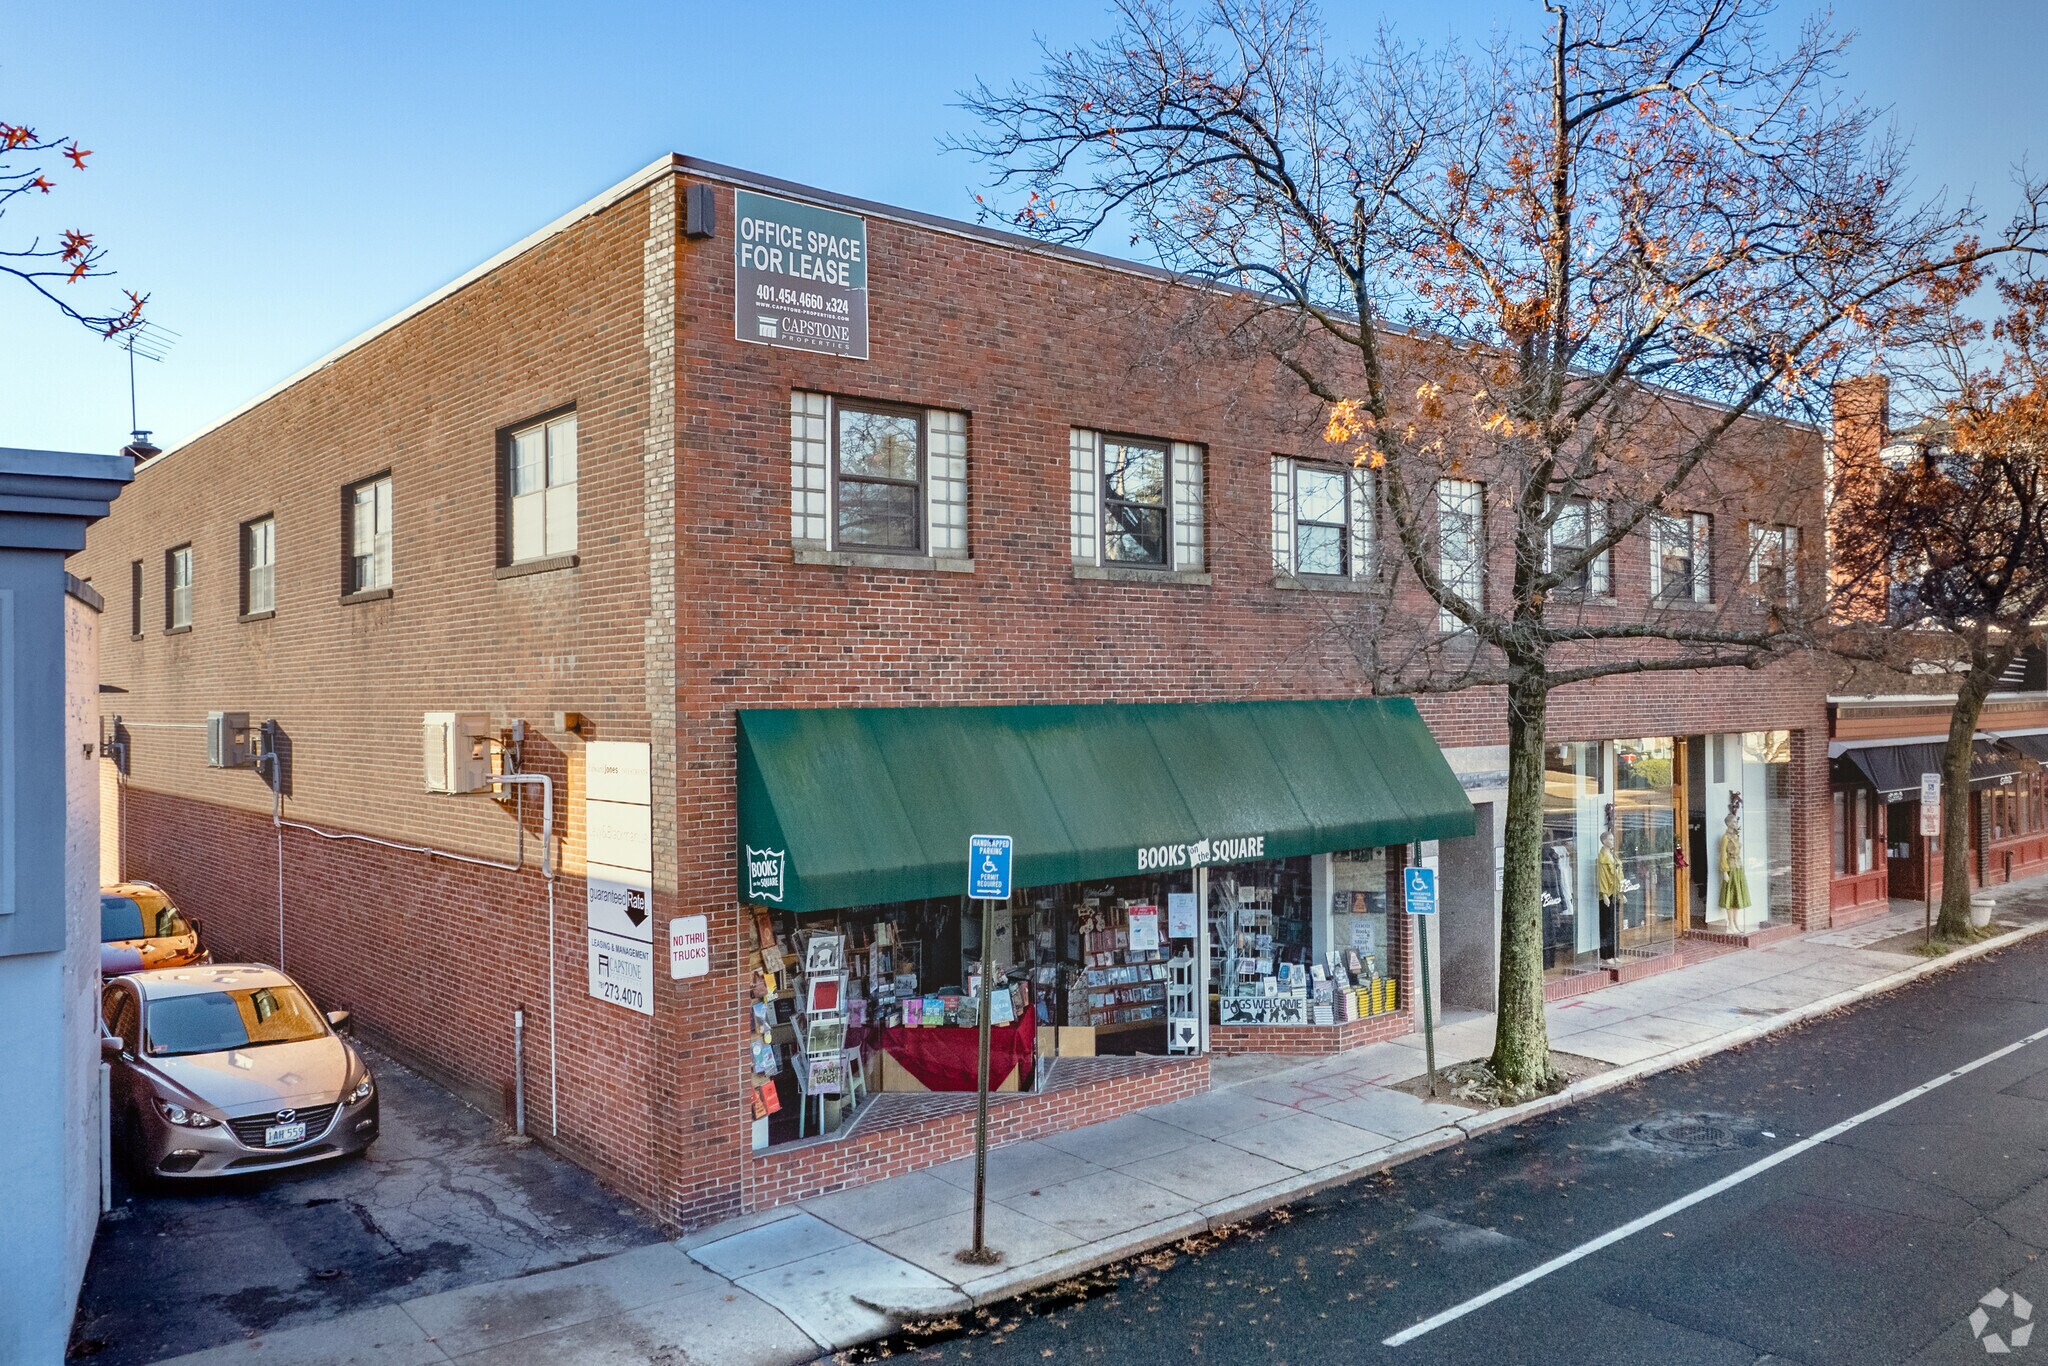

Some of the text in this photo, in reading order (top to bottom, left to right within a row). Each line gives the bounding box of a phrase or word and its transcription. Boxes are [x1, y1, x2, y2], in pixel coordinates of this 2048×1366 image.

[741, 217, 861, 262] OFFICE SPACE
[741, 243, 850, 287] FOR LEASE
[757, 284, 849, 314] 401.454.4660 x324
[782, 317, 849, 341] CAPSTONE
[781, 335, 850, 350] PROPERTIES
[979, 847, 1003, 856] PARKING
[1138, 836, 1264, 870] BOOKS on the SQUARE
[751, 860, 778, 878] BOOKS
[980, 873, 1000, 881] PERMIT
[761, 877, 779, 888] SQUARE
[977, 880, 1003, 888] REQUIRED
[590, 888, 645, 910] guaranteed Rate
[673, 932, 705, 947] NO THRU
[591, 938, 610, 950] LEASING
[615, 945, 649, 961] MANAGEMENT
[673, 947, 707, 961] TRUCKS
[609, 957, 642, 979] CAPSTONE
[604, 982, 643, 1008] 273.4070
[1223, 997, 1303, 1009] DGS WELCOME
[287, 1127, 304, 1138] 559
